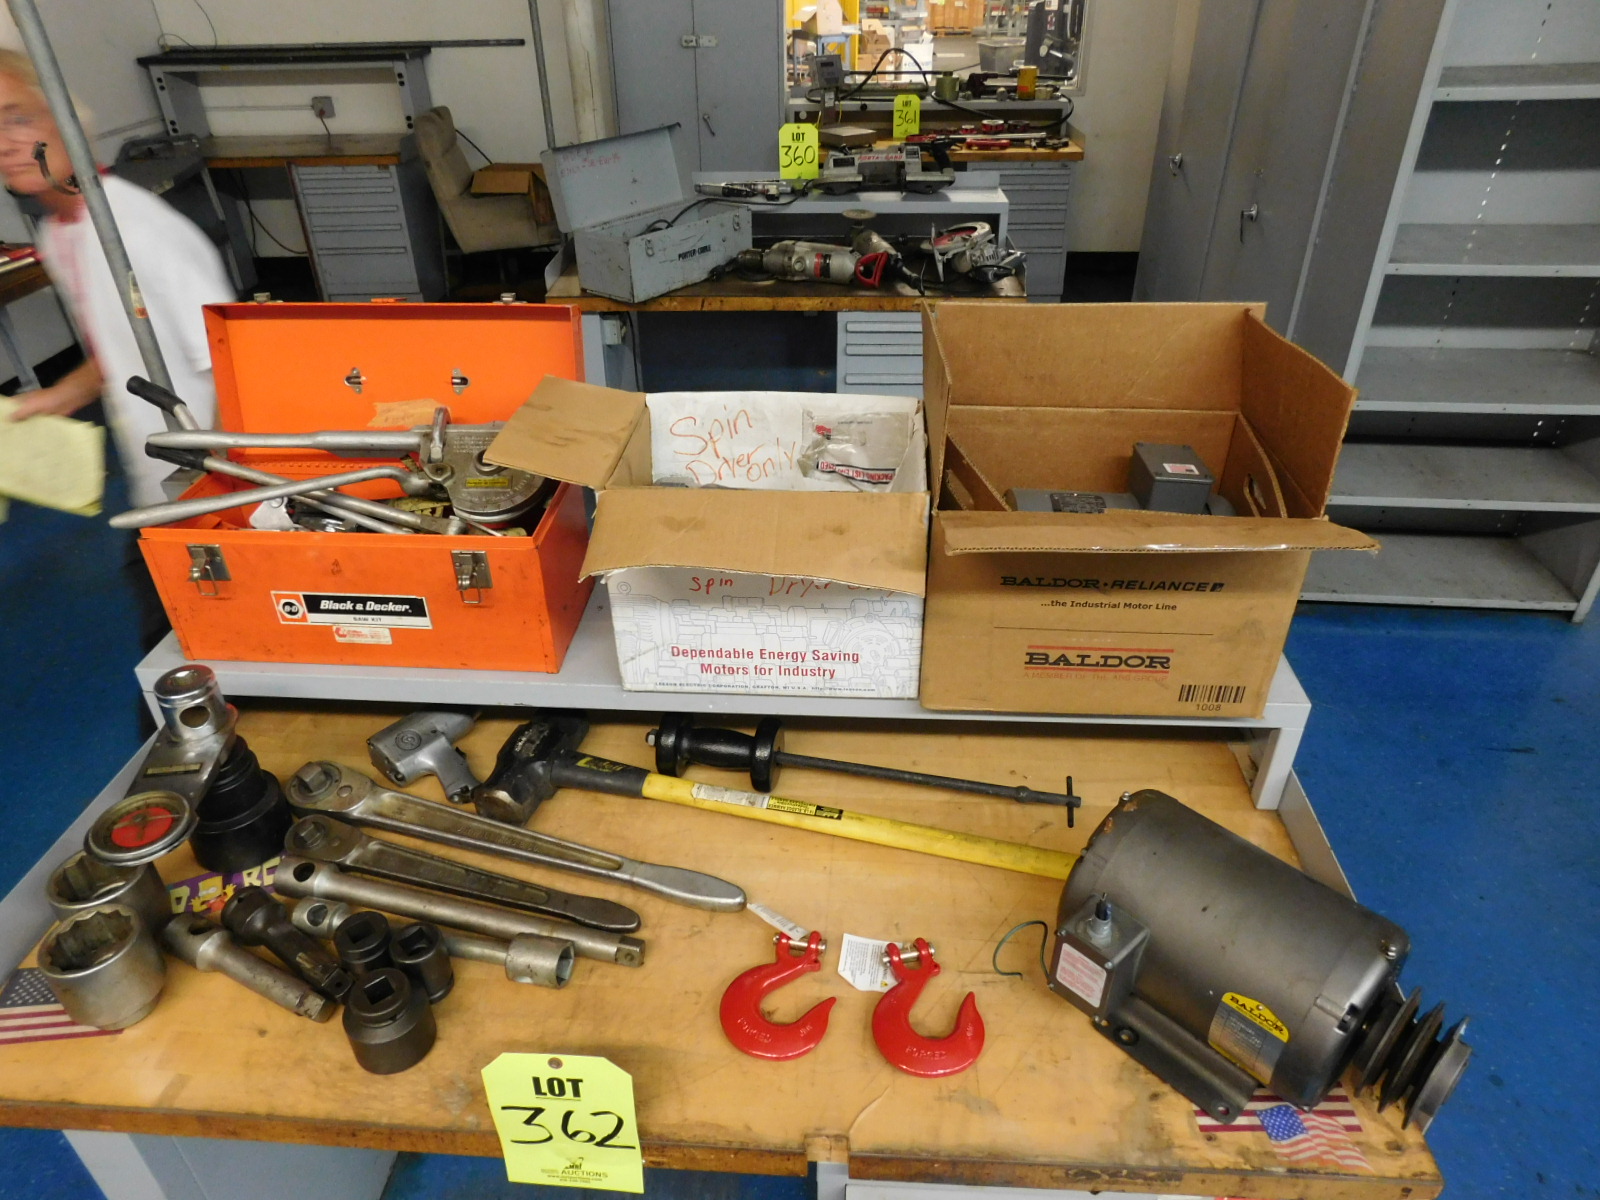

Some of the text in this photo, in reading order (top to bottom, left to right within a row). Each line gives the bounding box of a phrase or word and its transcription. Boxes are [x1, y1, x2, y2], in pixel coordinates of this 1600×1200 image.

[895, 109, 917, 127] 361
[791, 132, 805, 142] LOT
[781, 145, 816, 168] 360
[670, 405, 753, 459] Spin
[685, 437, 797, 486] Dryer only
[320, 600, 354, 610] Black
[355, 603, 364, 611] &
[1070, 600, 1121, 609] Industrial
[1123, 601, 1153, 611] Motor
[1155, 602, 1178, 611] Line
[671, 646, 860, 664] Dependable Energy Saving
[1024, 652, 1171, 669] BALDOR
[700, 663, 836, 680] Motors for Industry
[1196, 703, 1222, 712] 1008
[1229, 995, 1284, 1034] BALDOR
[532, 1076, 584, 1098] LOT
[501, 1106, 636, 1150] 362
[561, 1169, 609, 1178] AUCTIONS
